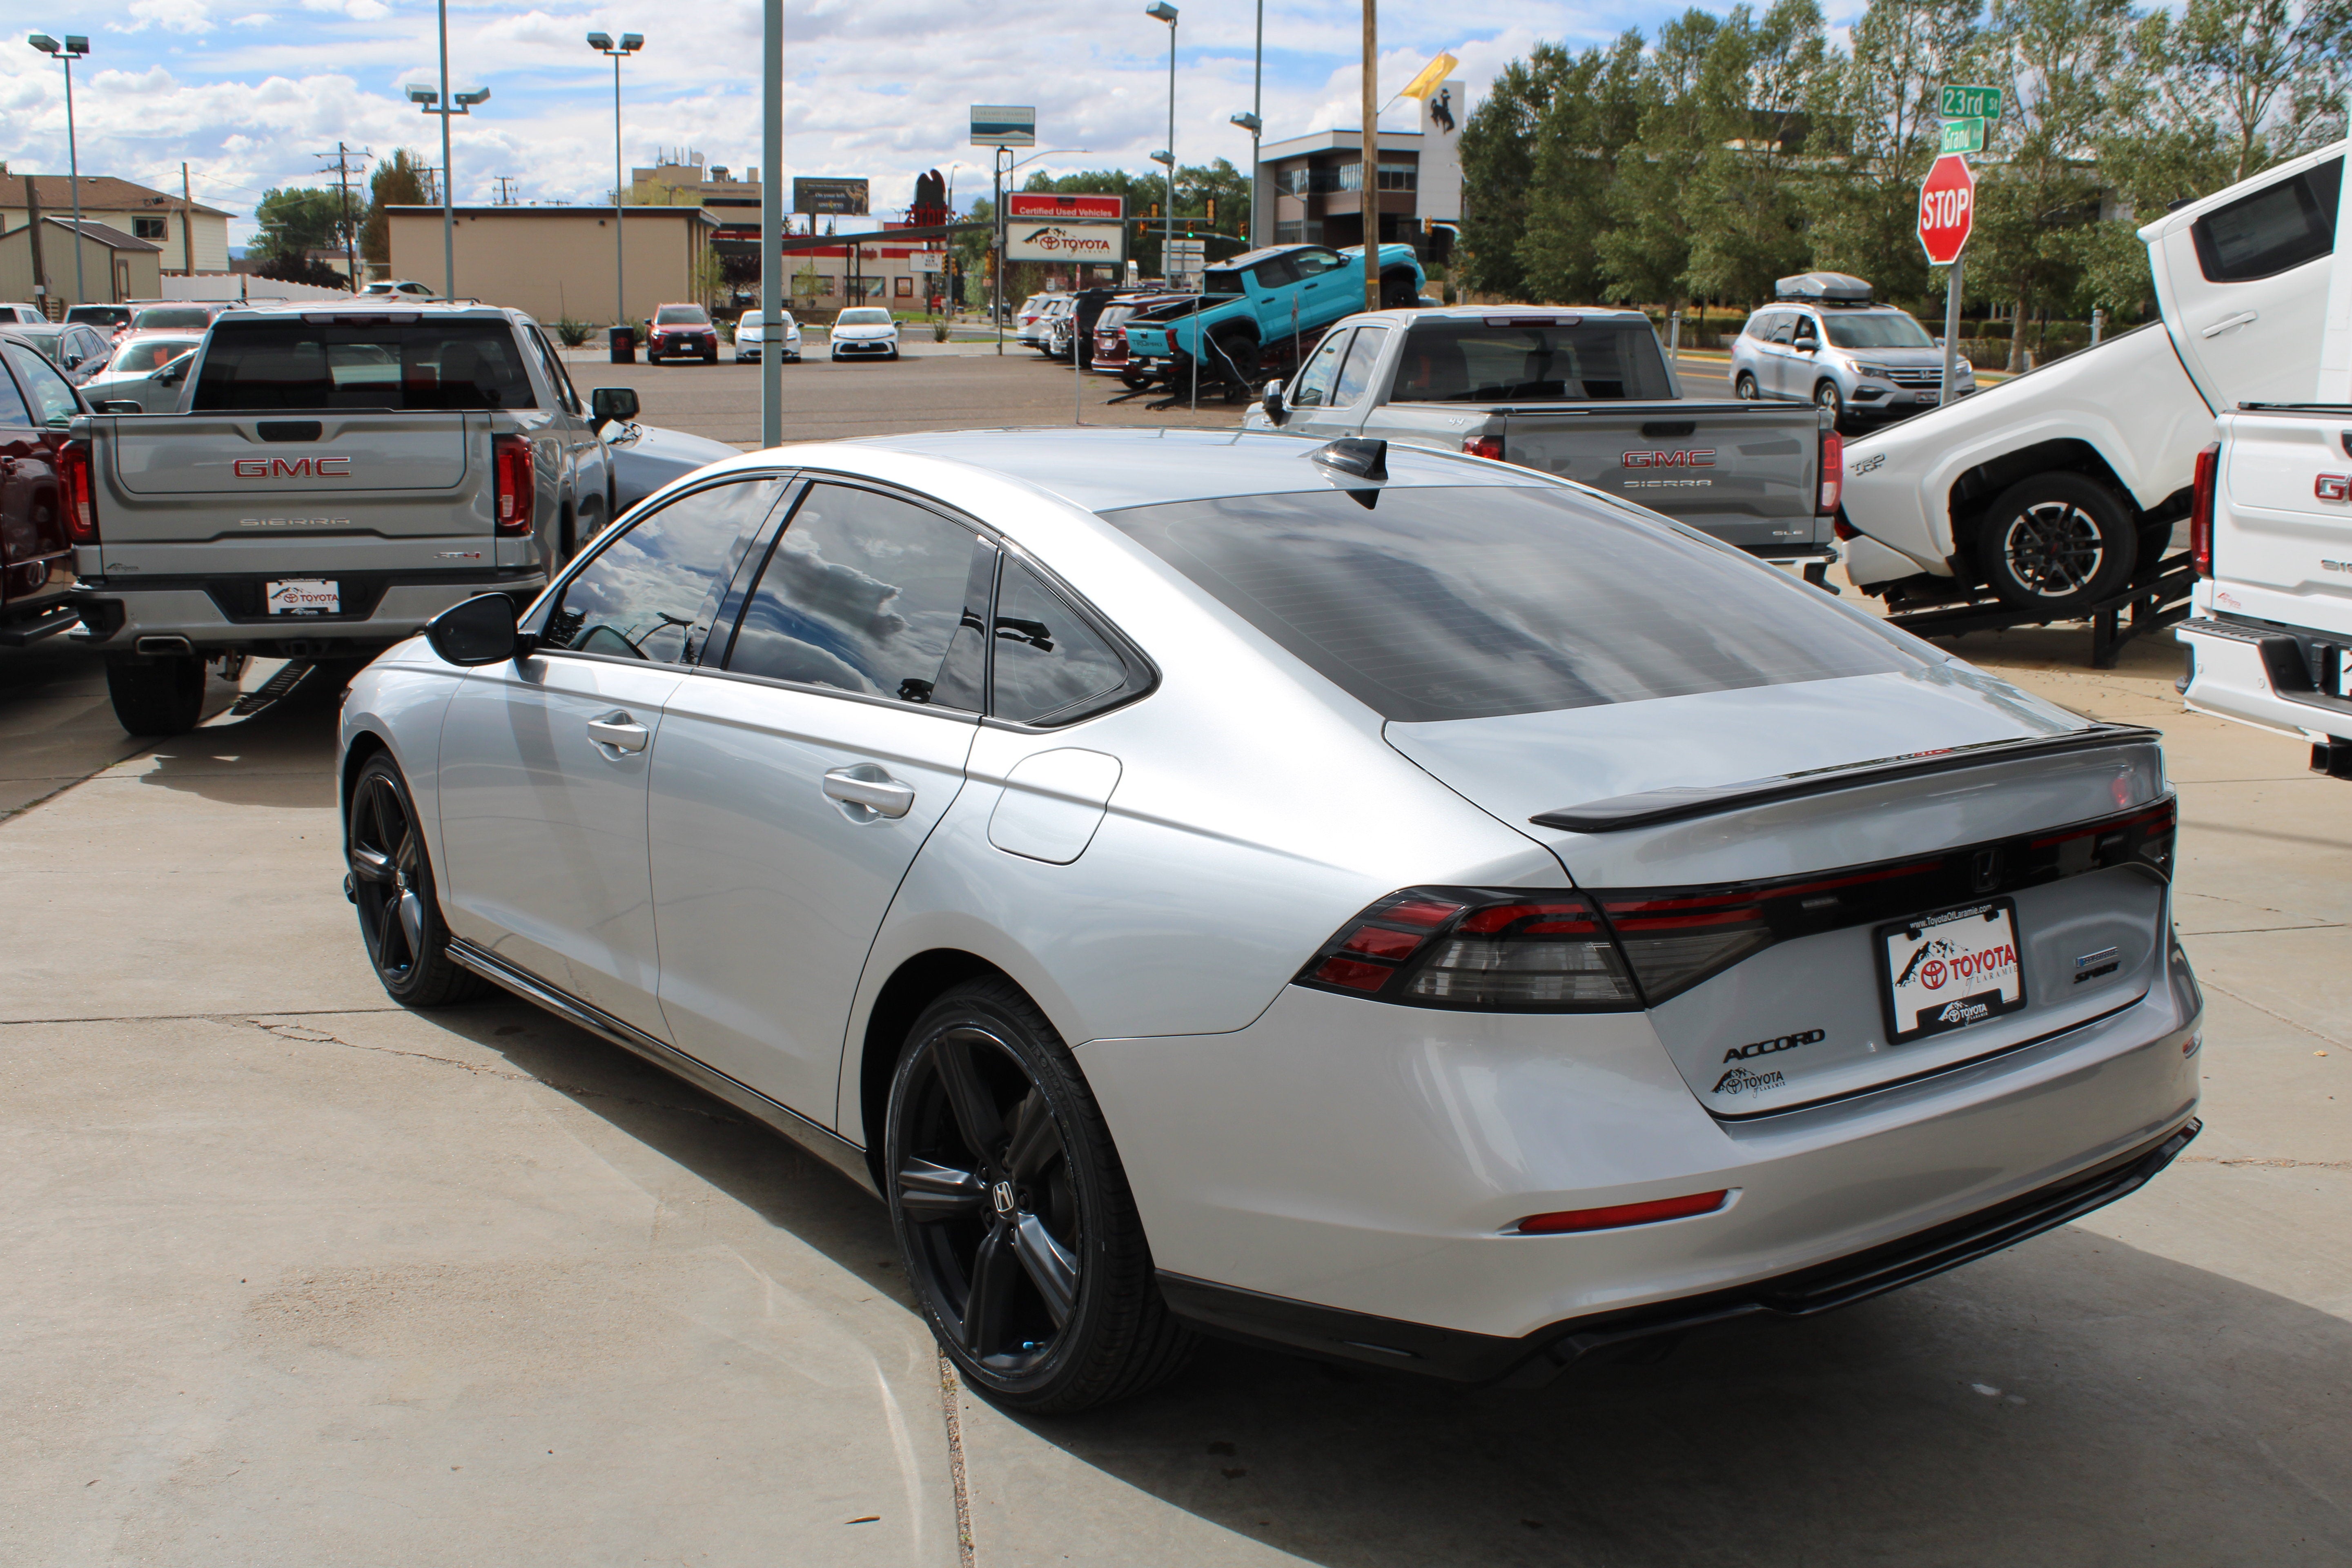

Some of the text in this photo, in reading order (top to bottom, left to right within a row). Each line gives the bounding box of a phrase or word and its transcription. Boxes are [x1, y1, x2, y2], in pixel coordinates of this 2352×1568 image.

[1943, 89, 1998, 115] 23rd St
[1945, 125, 1971, 150] Grand
[1079, 209, 1112, 217] Vehicles
[1923, 188, 1969, 230] STOP
[1062, 239, 1110, 249] TOYOTA
[232, 457, 351, 478] GMC
[1623, 450, 1715, 468] GMC
[1850, 453, 1886, 471] TRD
[1624, 479, 1712, 488] SIERRA
[2314, 471, 2352, 504] G
[240, 517, 350, 526] SIERRA
[2321, 559, 2352, 573] SI
[300, 594, 339, 602] TOYOTA
[1910, 904, 1992, 929] www.ToyotaOfLaramie.com
[1950, 944, 2018, 980] TOYOTA
[1977, 964, 2018, 983] LARAMIE
[1960, 1003, 1988, 1018] TOYOTA
[1971, 1011, 1989, 1020] LARAMIE
[1723, 1029, 1825, 1064] ACCORD
[1743, 1071, 1784, 1089] TOYOTA
[1759, 1081, 1786, 1091] LARAMIE
